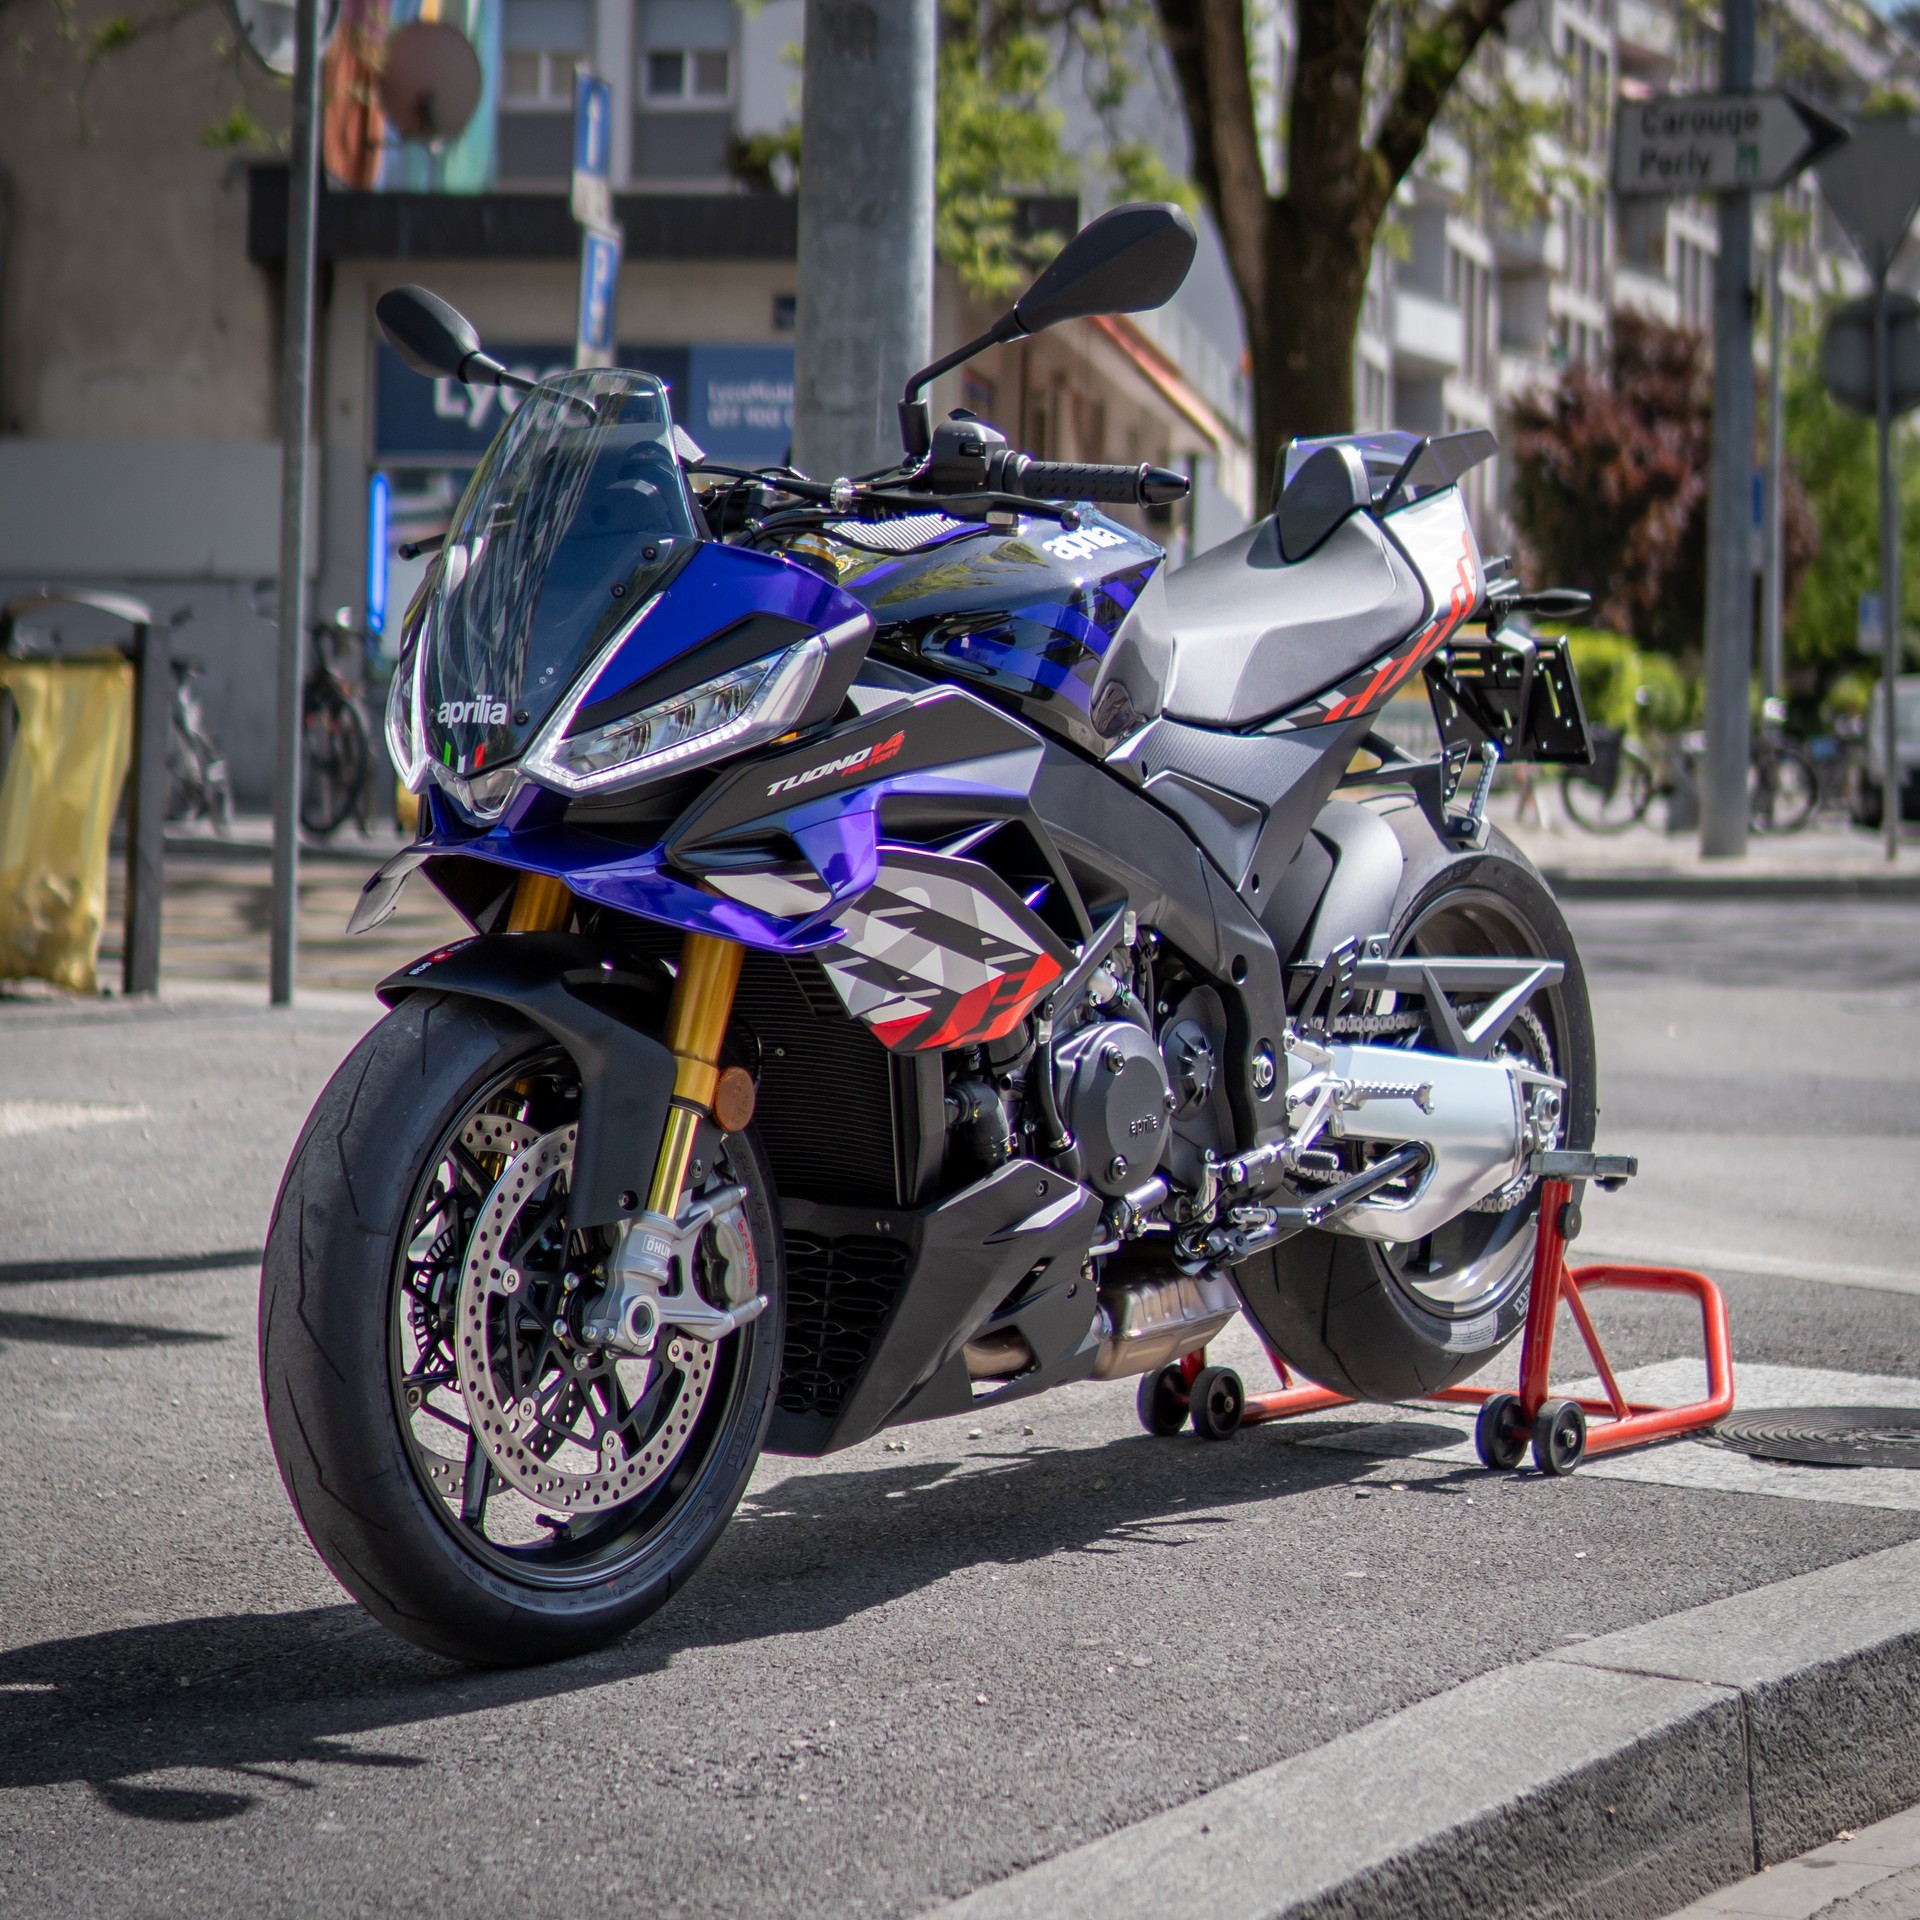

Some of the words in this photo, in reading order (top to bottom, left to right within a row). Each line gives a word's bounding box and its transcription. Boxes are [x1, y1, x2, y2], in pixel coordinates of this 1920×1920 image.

[1640, 104, 1760, 137] Carouge
[1639, 148, 1711, 178] Perly
[437, 694, 507, 729] aprilia
[767, 746, 872, 797] TUONO
[737, 1219, 758, 1289] brembo
